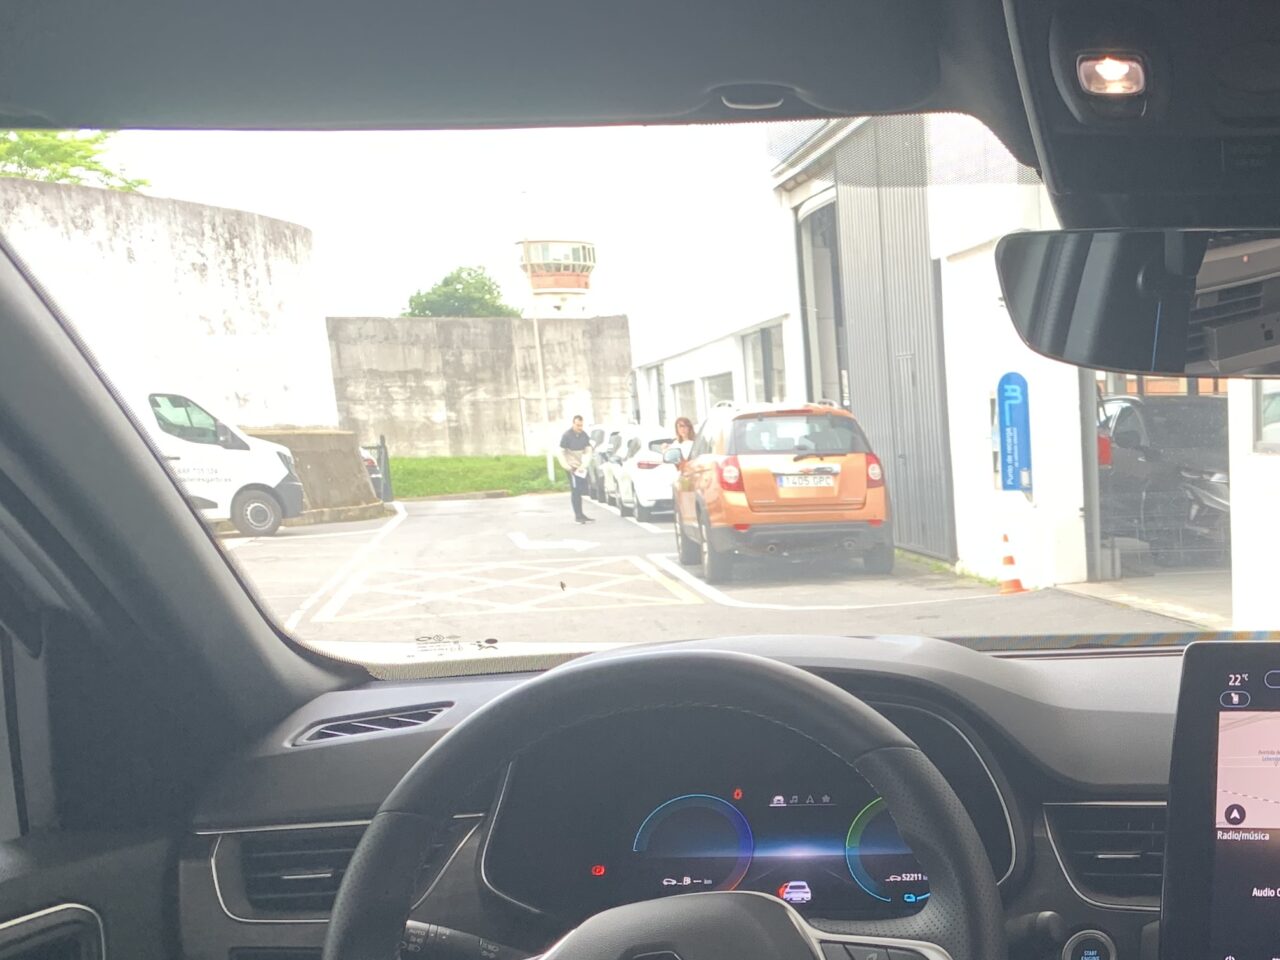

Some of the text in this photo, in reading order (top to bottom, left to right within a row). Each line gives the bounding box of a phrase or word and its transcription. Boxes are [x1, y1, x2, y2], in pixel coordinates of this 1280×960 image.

[1217, 831, 1270, 842] Radio/música
[902, 873, 922, 881] 52211
[1252, 887, 1275, 898] Audio
